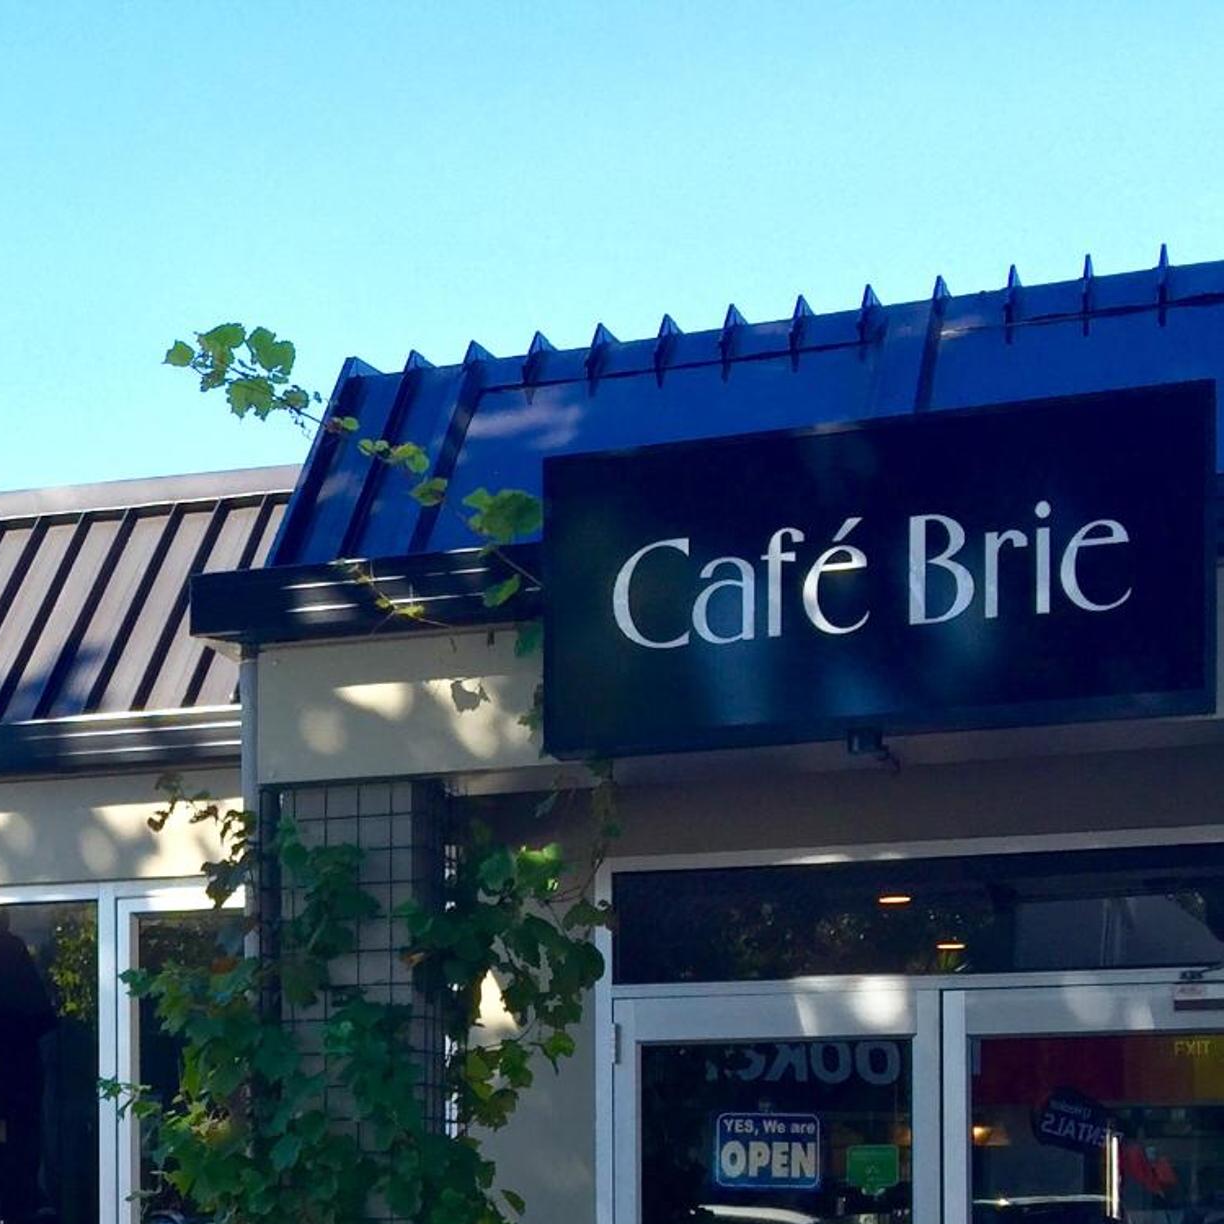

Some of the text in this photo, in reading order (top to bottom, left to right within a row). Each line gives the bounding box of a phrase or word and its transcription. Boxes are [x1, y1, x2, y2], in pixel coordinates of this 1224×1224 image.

[612, 500, 1133, 649] Café Brie
[1174, 1040, 1211, 1056] EXIT
[723, 1119, 816, 1135] YES, We are
[720, 1139, 816, 1178] OPEN
